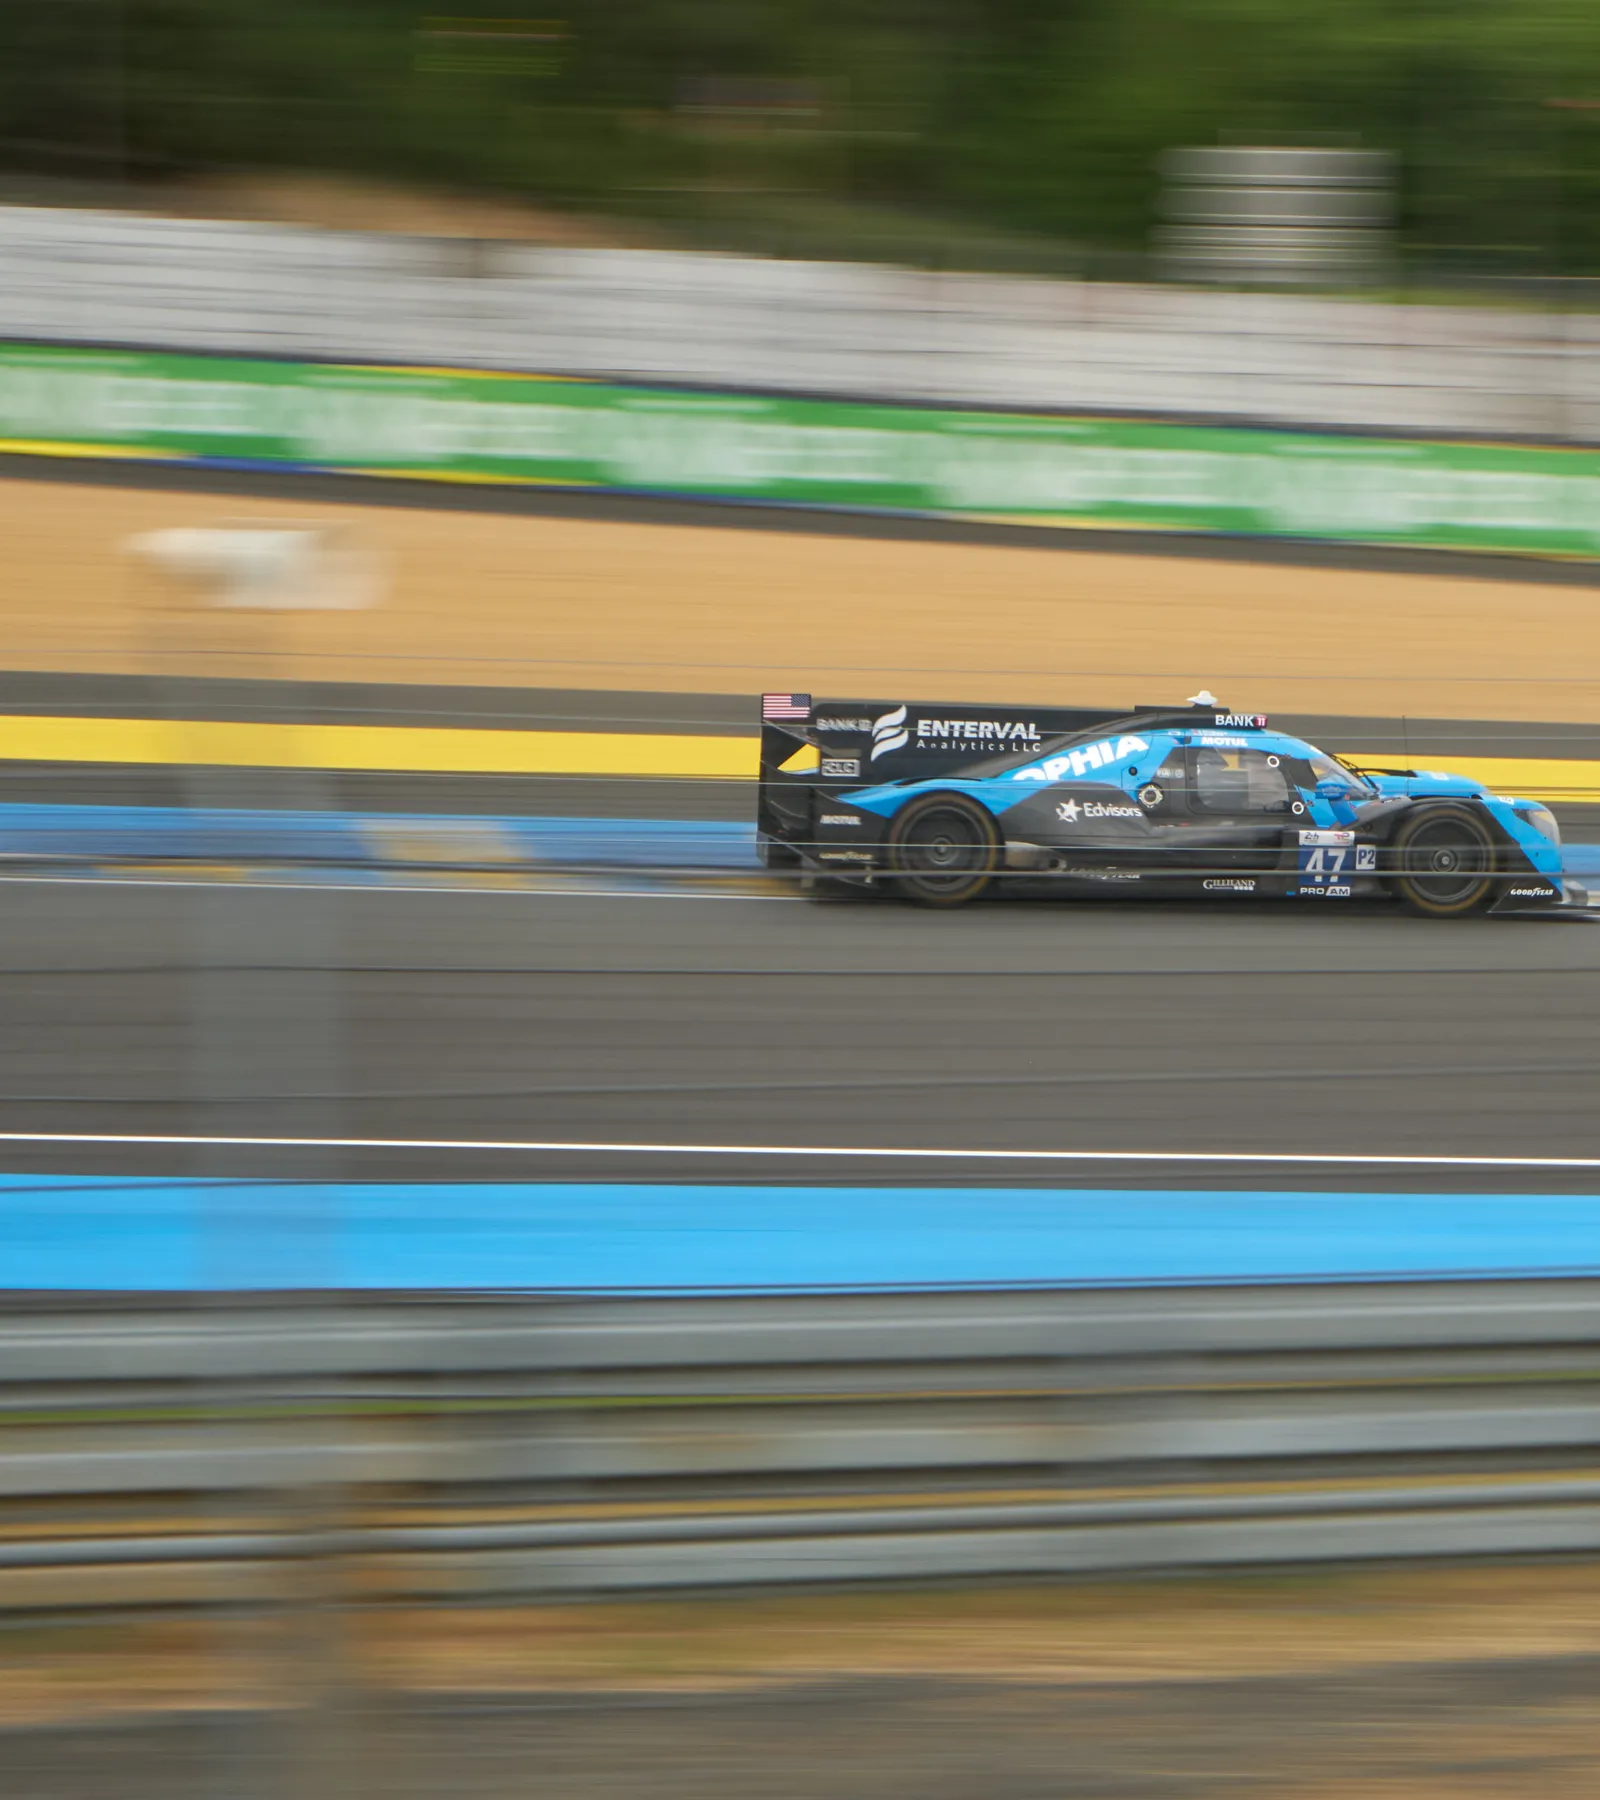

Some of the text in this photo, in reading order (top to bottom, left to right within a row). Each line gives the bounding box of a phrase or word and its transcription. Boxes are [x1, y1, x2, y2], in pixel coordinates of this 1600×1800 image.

[1215, 714, 1254, 727] BANK
[917, 719, 1041, 740] ENTERVAL
[916, 739, 1041, 752] Analytics LLC
[1201, 736, 1248, 747] MOTUL
[1083, 802, 1143, 818] Edvisors
[1358, 848, 1375, 865] P2
[1305, 847, 1346, 883] 47
[1300, 887, 1350, 896] PRO AM
[1510, 886, 1554, 897] GOODYEAR
